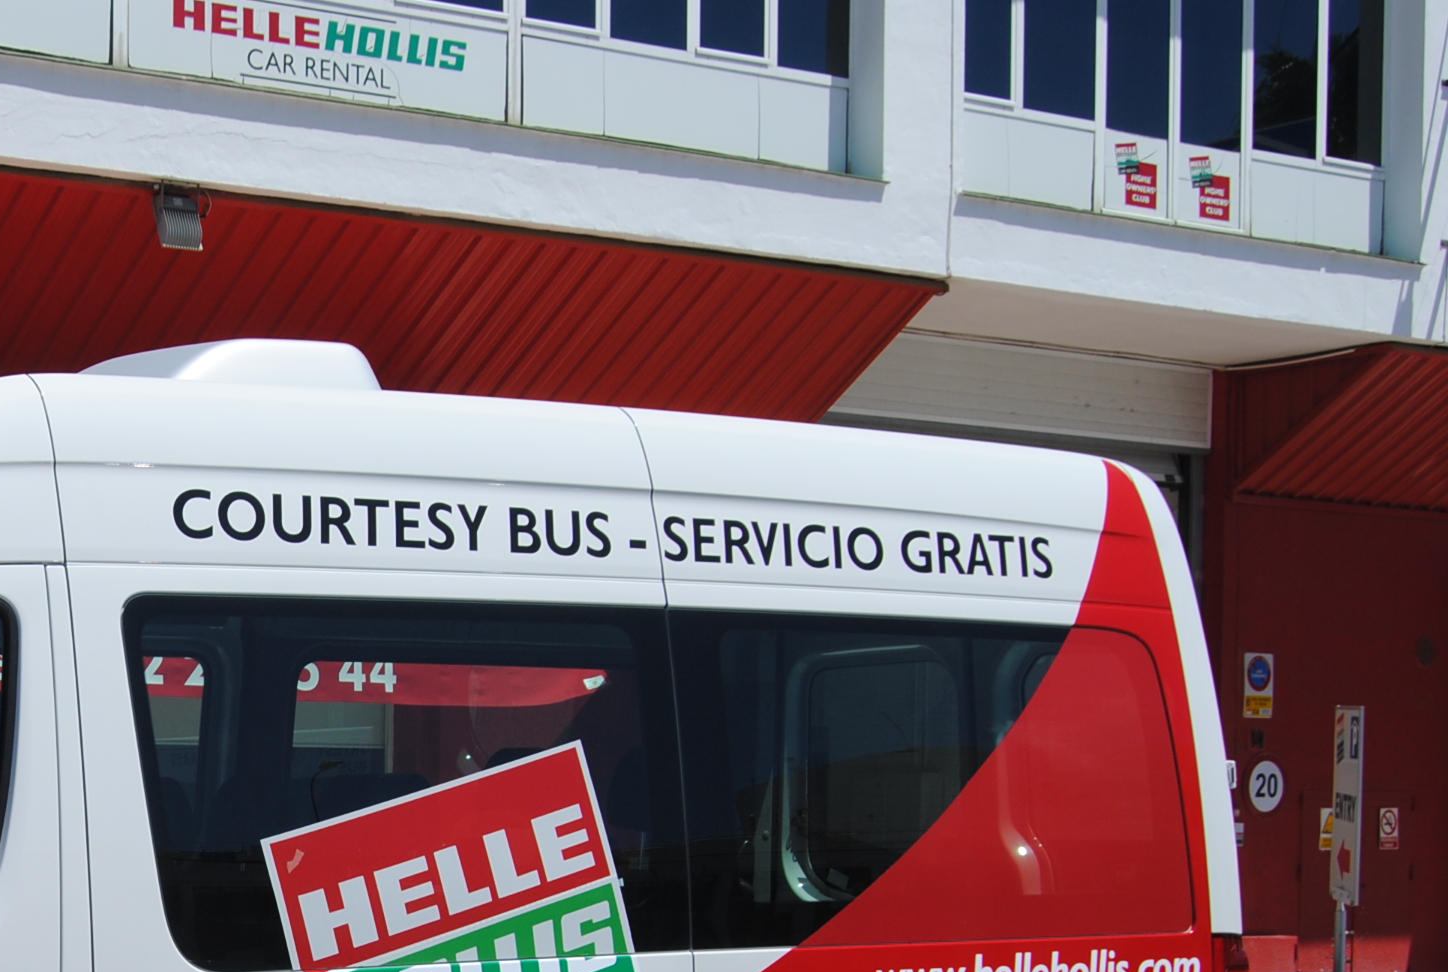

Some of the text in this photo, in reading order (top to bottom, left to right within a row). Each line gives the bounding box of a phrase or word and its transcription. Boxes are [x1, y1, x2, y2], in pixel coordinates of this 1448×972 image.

[247, 48, 391, 90] CAR RENTAL
[1131, 193, 1151, 204] CLUB
[1205, 206, 1224, 216] CLUB
[172, 488, 488, 552] COURTESY
[508, 506, 612, 559] BUS
[663, 516, 884, 571] SERVICIO
[900, 529, 1053, 579] GRATIS
[1254, 772, 1279, 798] 20
[1335, 792, 1357, 823] ENTRY
[297, 803, 596, 962] HELLE
